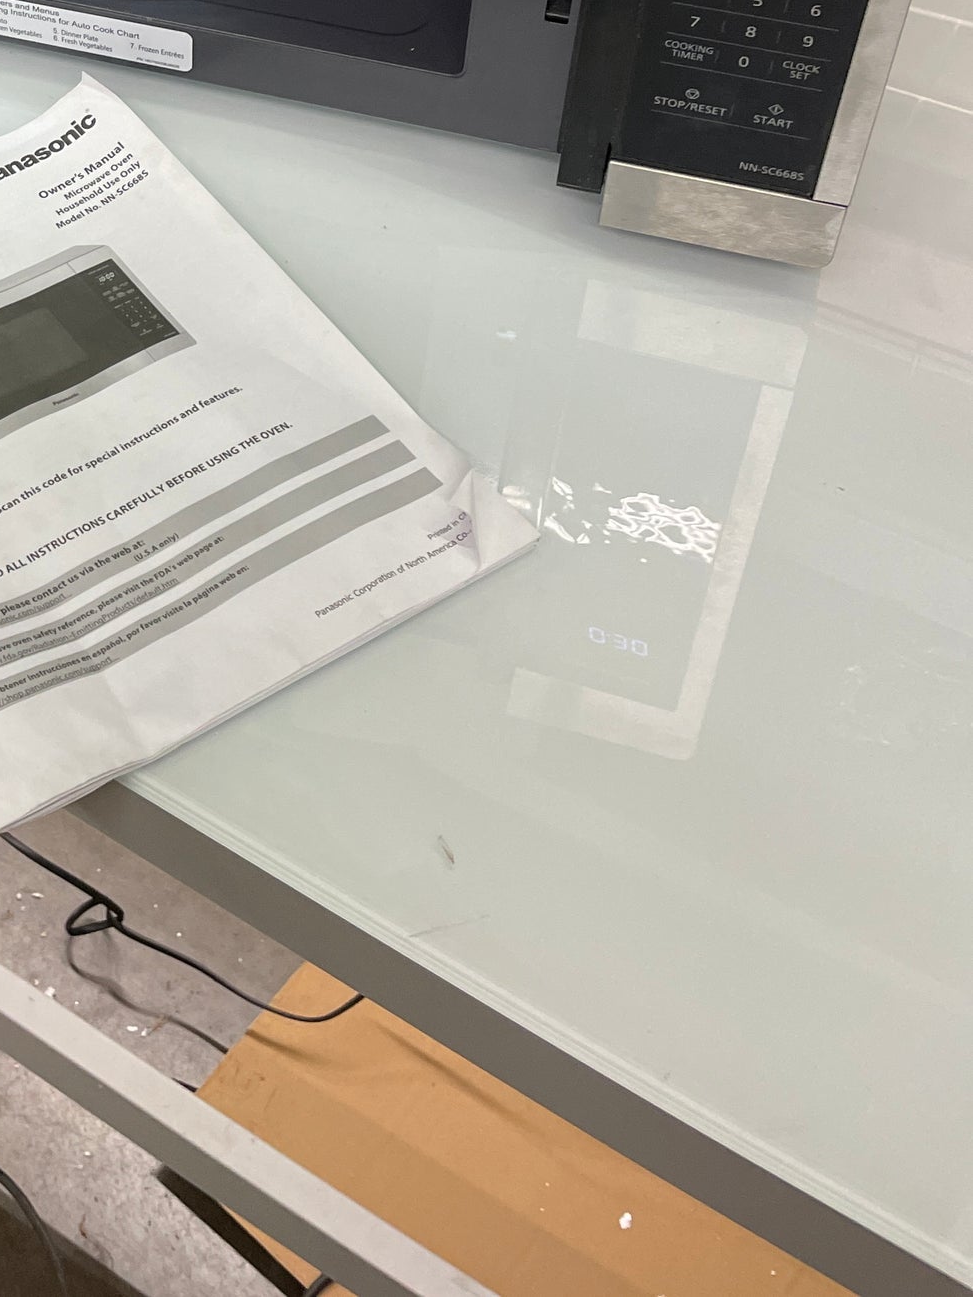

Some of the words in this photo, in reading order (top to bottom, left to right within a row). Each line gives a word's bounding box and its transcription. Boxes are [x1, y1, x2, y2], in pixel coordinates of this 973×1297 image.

[15, 1, 30, 11] and
[33, 6, 60, 17] Menus
[810, 5, 821, 17] 6
[11, 8, 56, 24] Instructions
[58, 17, 70, 26] for
[71, 20, 91, 31] Auto
[92, 24, 115, 35] Cook
[116, 29, 140, 40] Chart
[690, 16, 701, 27] 7
[8, 25, 43, 39] Vegetables
[52, 27, 58, 37] 5.
[60, 29, 82, 39] Dinner
[82, 33, 99, 43] Plate
[746, 26, 757, 38] 8
[52, 34, 60, 42] 6.
[61, 36, 78, 46] Fresh
[78, 39, 113, 53] Vegetables
[664, 39, 714, 55] COOKING
[803, 36, 813, 48] 9
[130, 42, 135, 50] 7.
[137, 44, 160, 55] Frozen
[160, 48, 185, 60] Entrées
[672, 50, 704, 62] TIMER
[739, 56, 749, 68] 0
[783, 61, 821, 73] CLOCK
[790, 71, 810, 81] SET
[654, 95, 727, 117] STOP/RESET
[753, 115, 793, 129] START
[38, 172, 85, 199] Owner's
[83, 141, 125, 175] Manual
[63, 170, 112, 201] Microwave
[110, 153, 134, 172] Oven
[739, 161, 805, 181] NN-SC668S
[55, 186, 105, 216] Household
[102, 176, 121, 190] Use
[119, 160, 141, 178] Only
[55, 210, 86, 229] Model
[83, 204, 102, 215] No.
[99, 169, 149, 206] NN-SC668S
[20, 485, 42, 501] this
[42, 472, 68, 489] code
[67, 465, 84, 477] for
[84, 446, 121, 470] special
[118, 416, 180, 451] instructions
[179, 403, 200, 419] and
[198, 386, 243, 409] features.
[5, 559, 28, 574] ALL
[25, 516, 106, 563] INSTRUCTIONS
[105, 483, 165, 521] CAREFULLY
[165, 463, 208, 489] BEFORE
[205, 446, 241, 468] USING
[237, 434, 262, 450] THE
[259, 421, 293, 440] OVEN.
[0, 599, 31, 616] please
[31, 580, 68, 603] contact
[66, 574, 80, 584] us
[78, 565, 95, 577] via
[93, 556, 112, 569] the
[110, 546, 132, 560] web
[131, 540, 146, 551] at:
